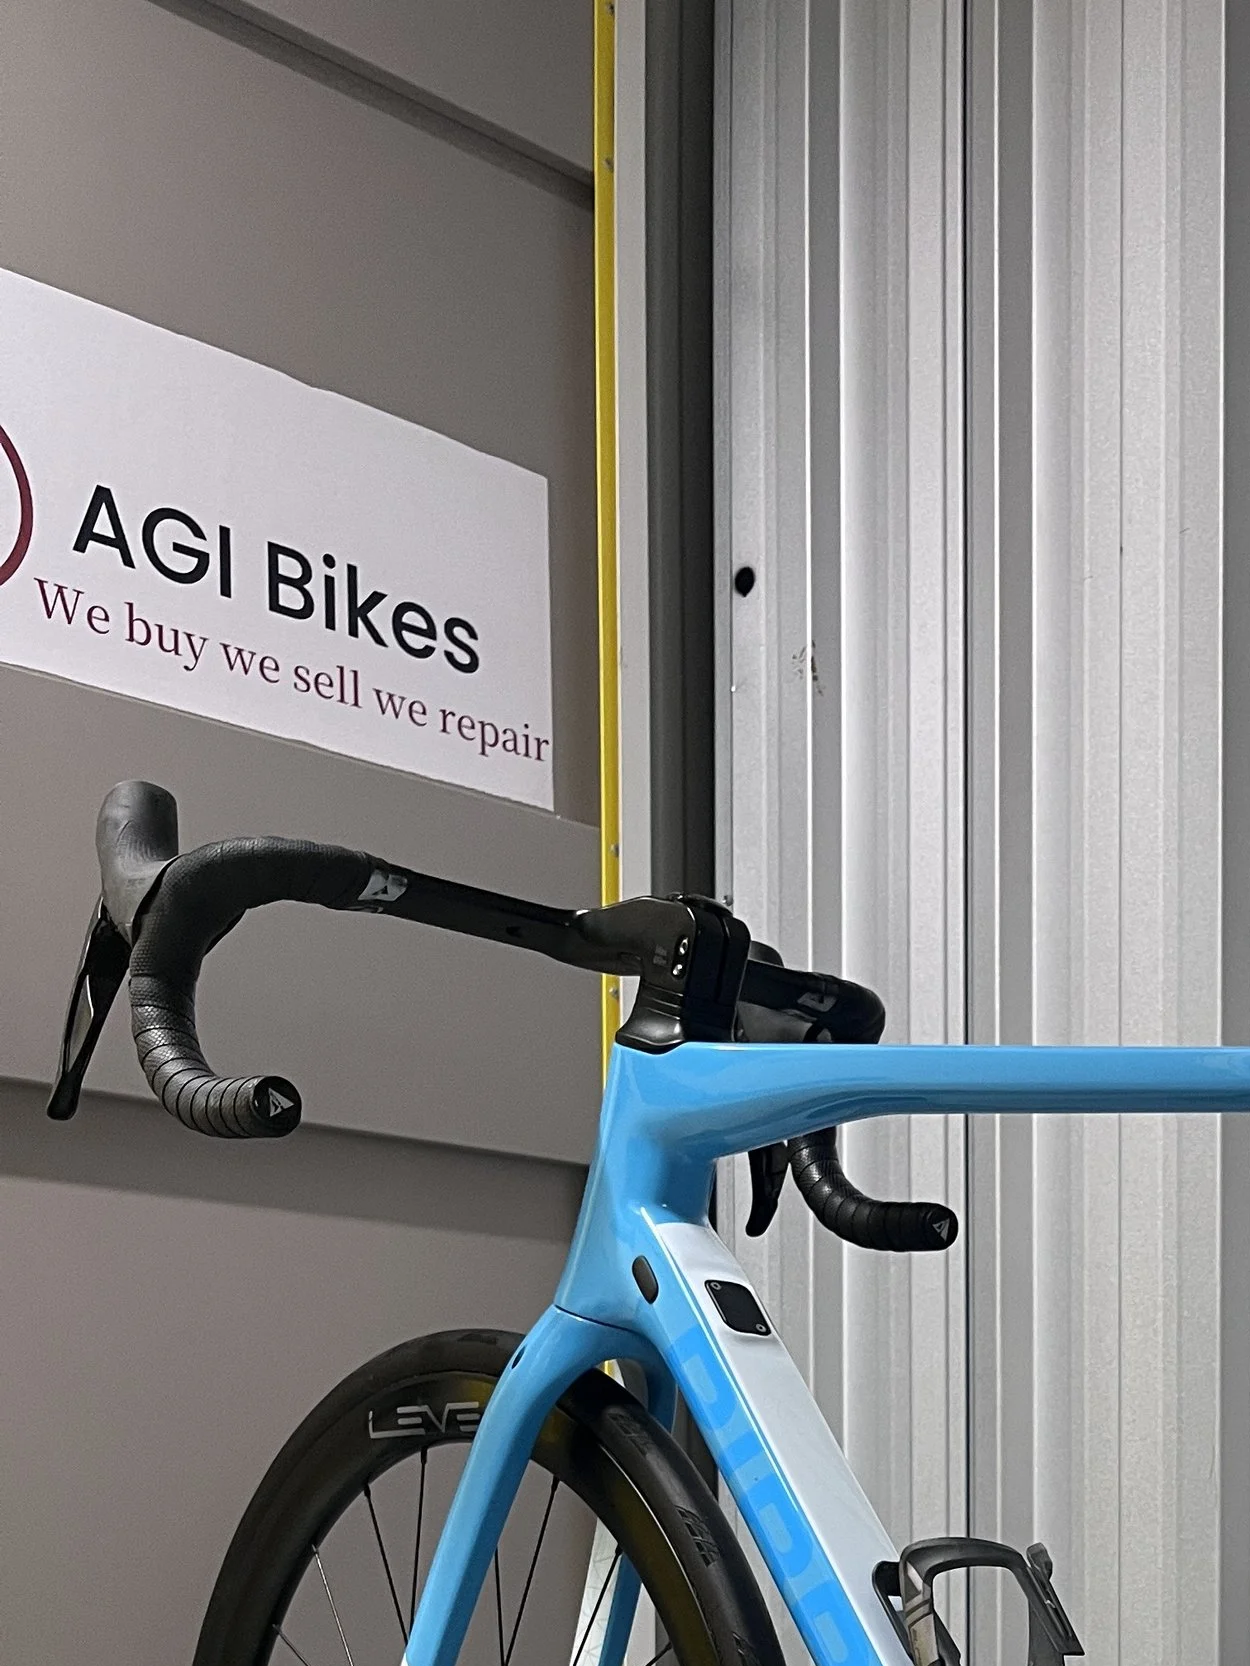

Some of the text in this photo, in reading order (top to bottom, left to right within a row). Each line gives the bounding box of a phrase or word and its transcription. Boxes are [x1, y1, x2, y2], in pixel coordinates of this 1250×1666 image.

[33, 577, 550, 762] We buy we sell we repair
[72, 485, 479, 674] AGI Bikes
[368, 1402, 480, 1439] LEVE
